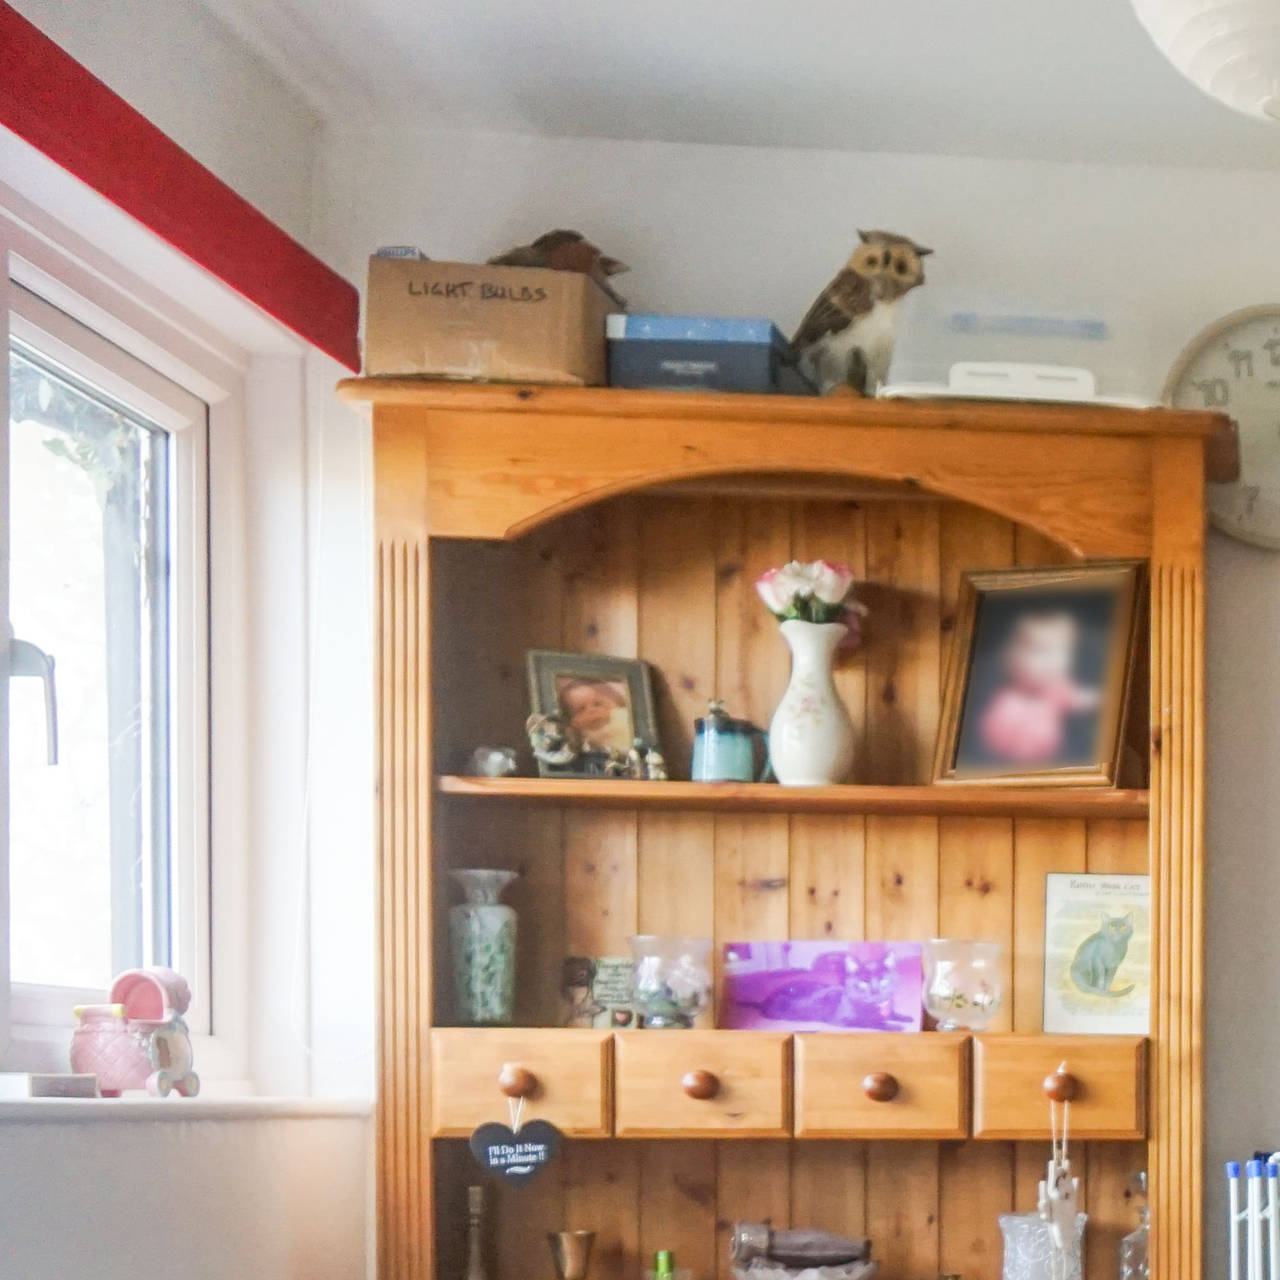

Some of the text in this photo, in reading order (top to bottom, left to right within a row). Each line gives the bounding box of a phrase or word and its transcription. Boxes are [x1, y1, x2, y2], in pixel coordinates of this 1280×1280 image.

[408, 280, 548, 302] LIGHT BULBS
[1228, 349, 1254, 377] 11
[1198, 378, 1229, 407] 10
[1241, 485, 1260, 515] 7
[488, 1143, 545, 1155] I'll Do It Now
[489, 1155, 498, 1165] in
[507, 1153, 537, 1164] Minute
